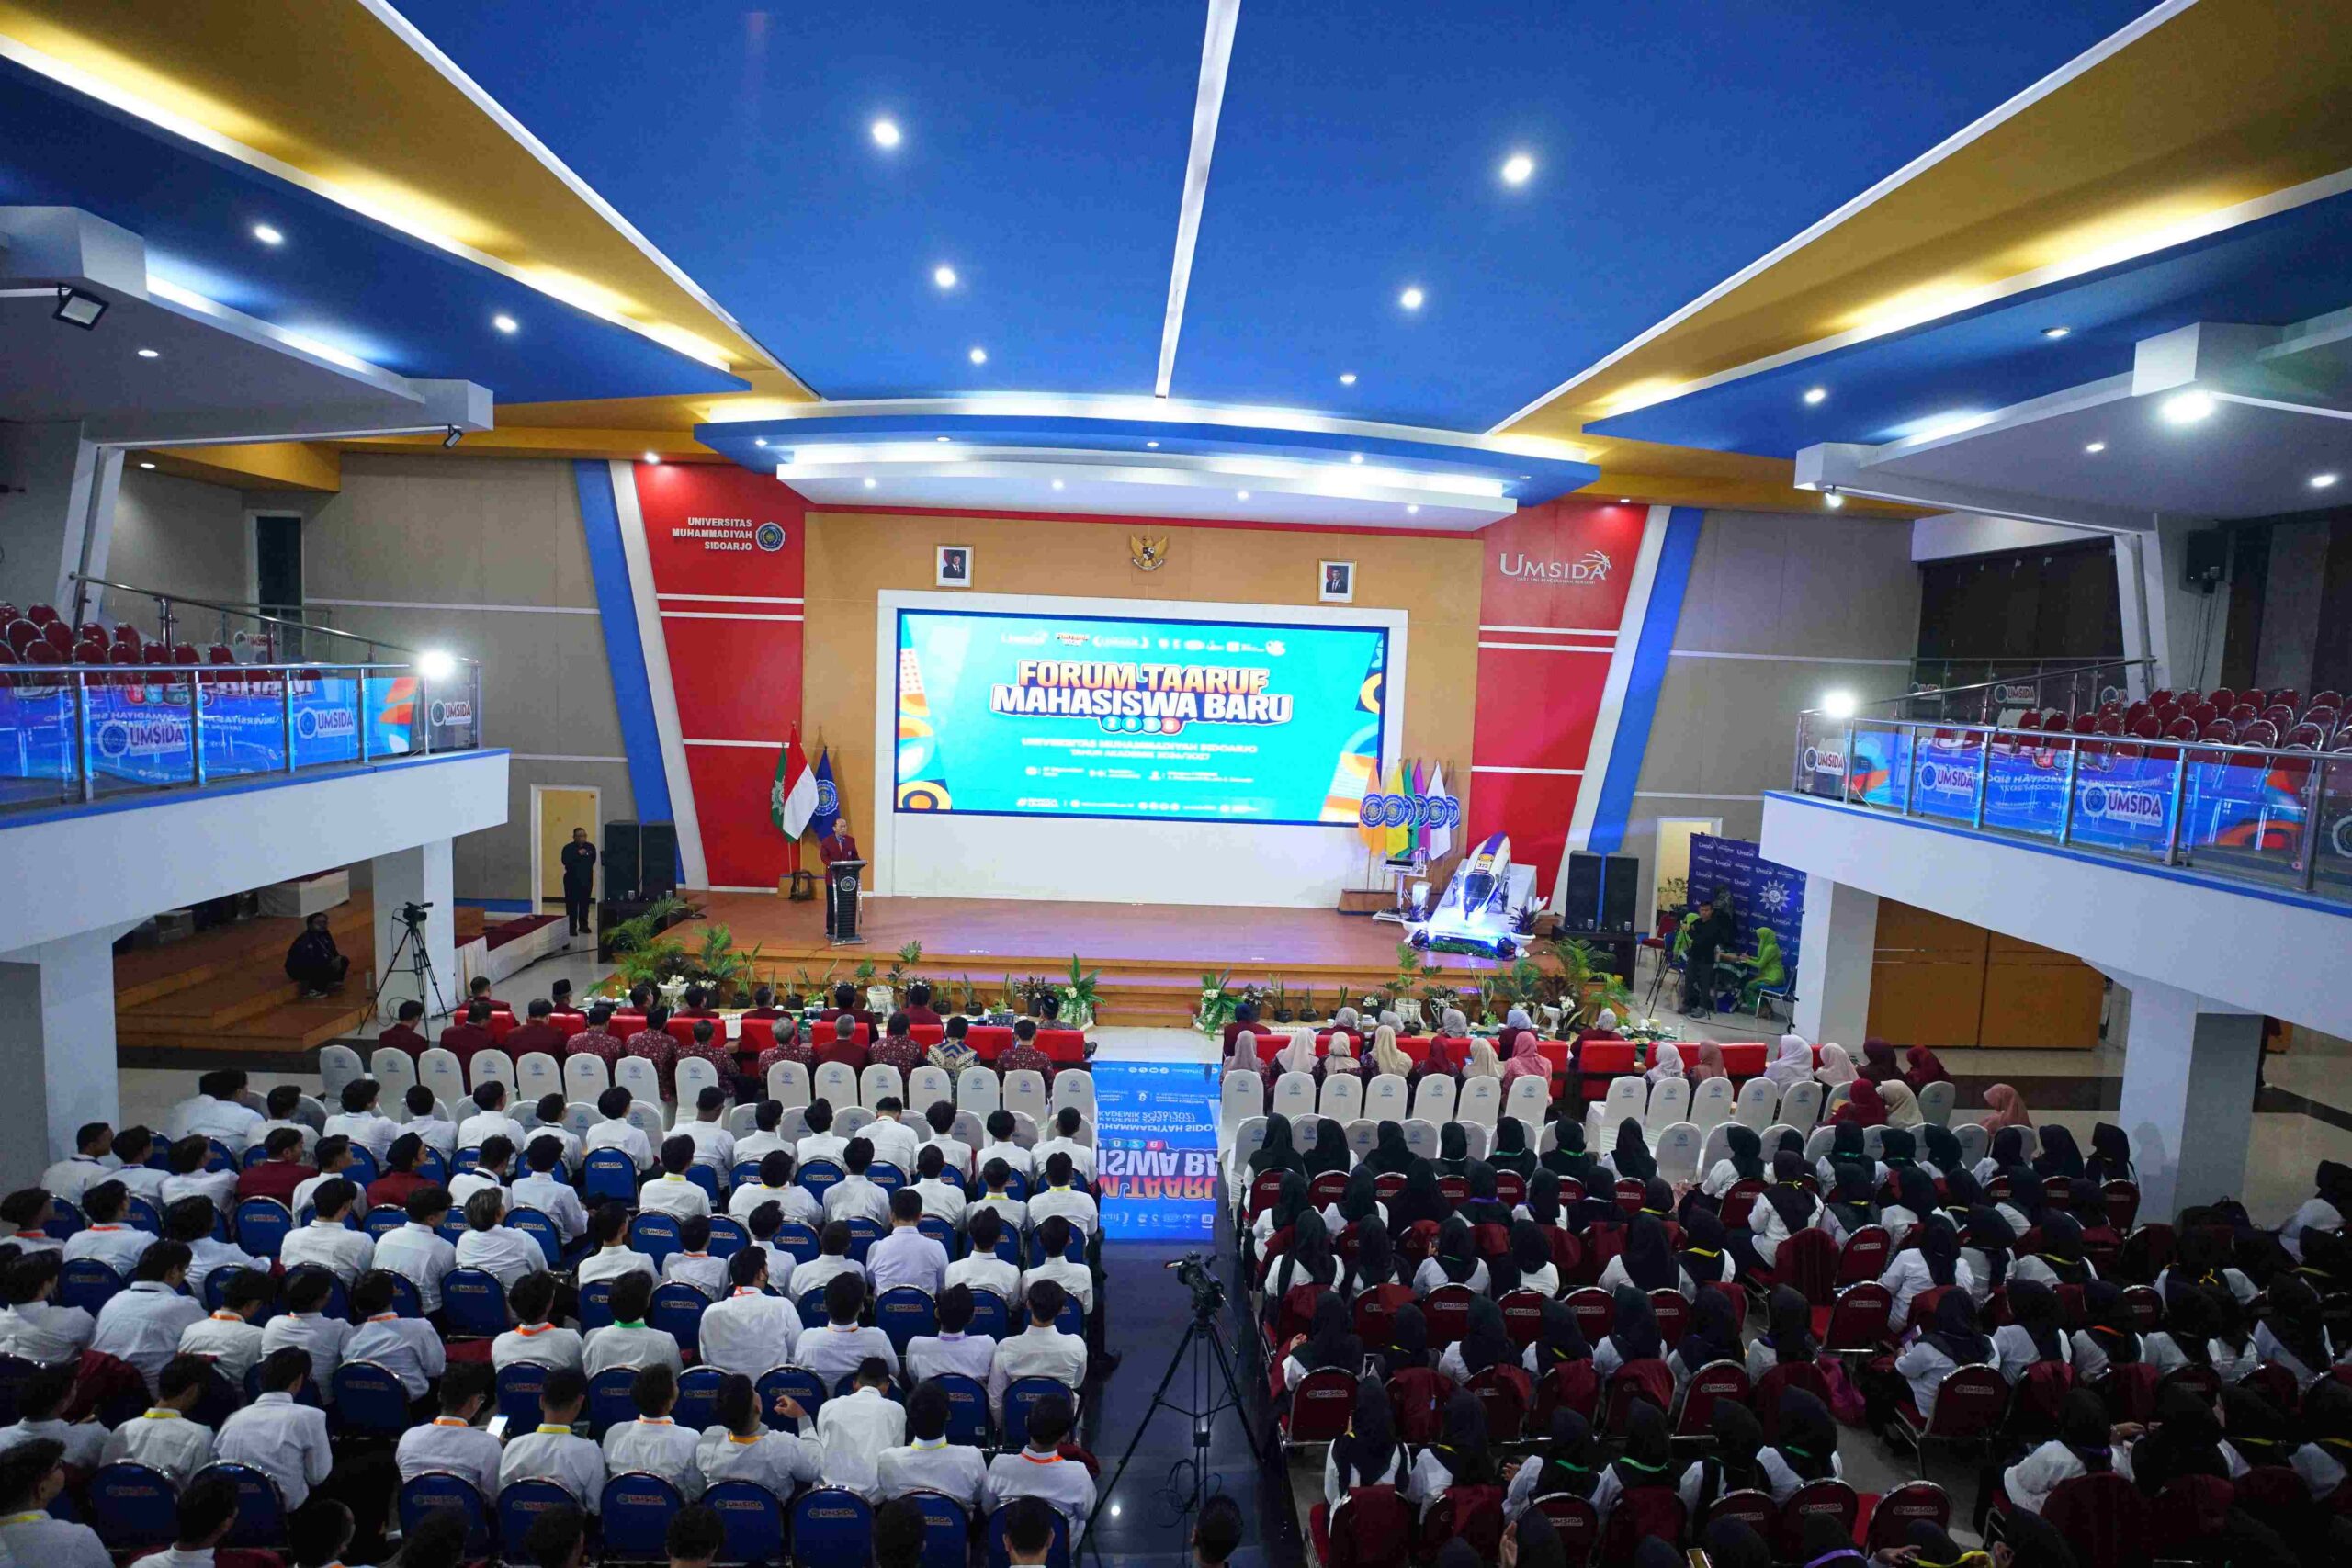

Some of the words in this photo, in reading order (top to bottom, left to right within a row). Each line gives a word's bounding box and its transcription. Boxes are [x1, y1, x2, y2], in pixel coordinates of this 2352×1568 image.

[687, 517, 752, 527] UNIVERSITAS
[672, 528, 752, 539] MUHAMMADIYAH
[704, 541, 752, 551] SIDOARJO
[1019, 660, 1136, 690] FORUM
[1143, 664, 1267, 694] TAARUF
[445, 704, 471, 718] UMSIDA
[992, 685, 1197, 717] MAHASISWA
[1204, 693, 1291, 722] BARU
[317, 710, 354, 729] UMSIDA
[130, 725, 185, 746] UMSIDA
[1817, 753, 1844, 769] UMSIDA
[1937, 770, 1973, 789] UMSIDA
[2109, 792, 2162, 817] UMSIDA
